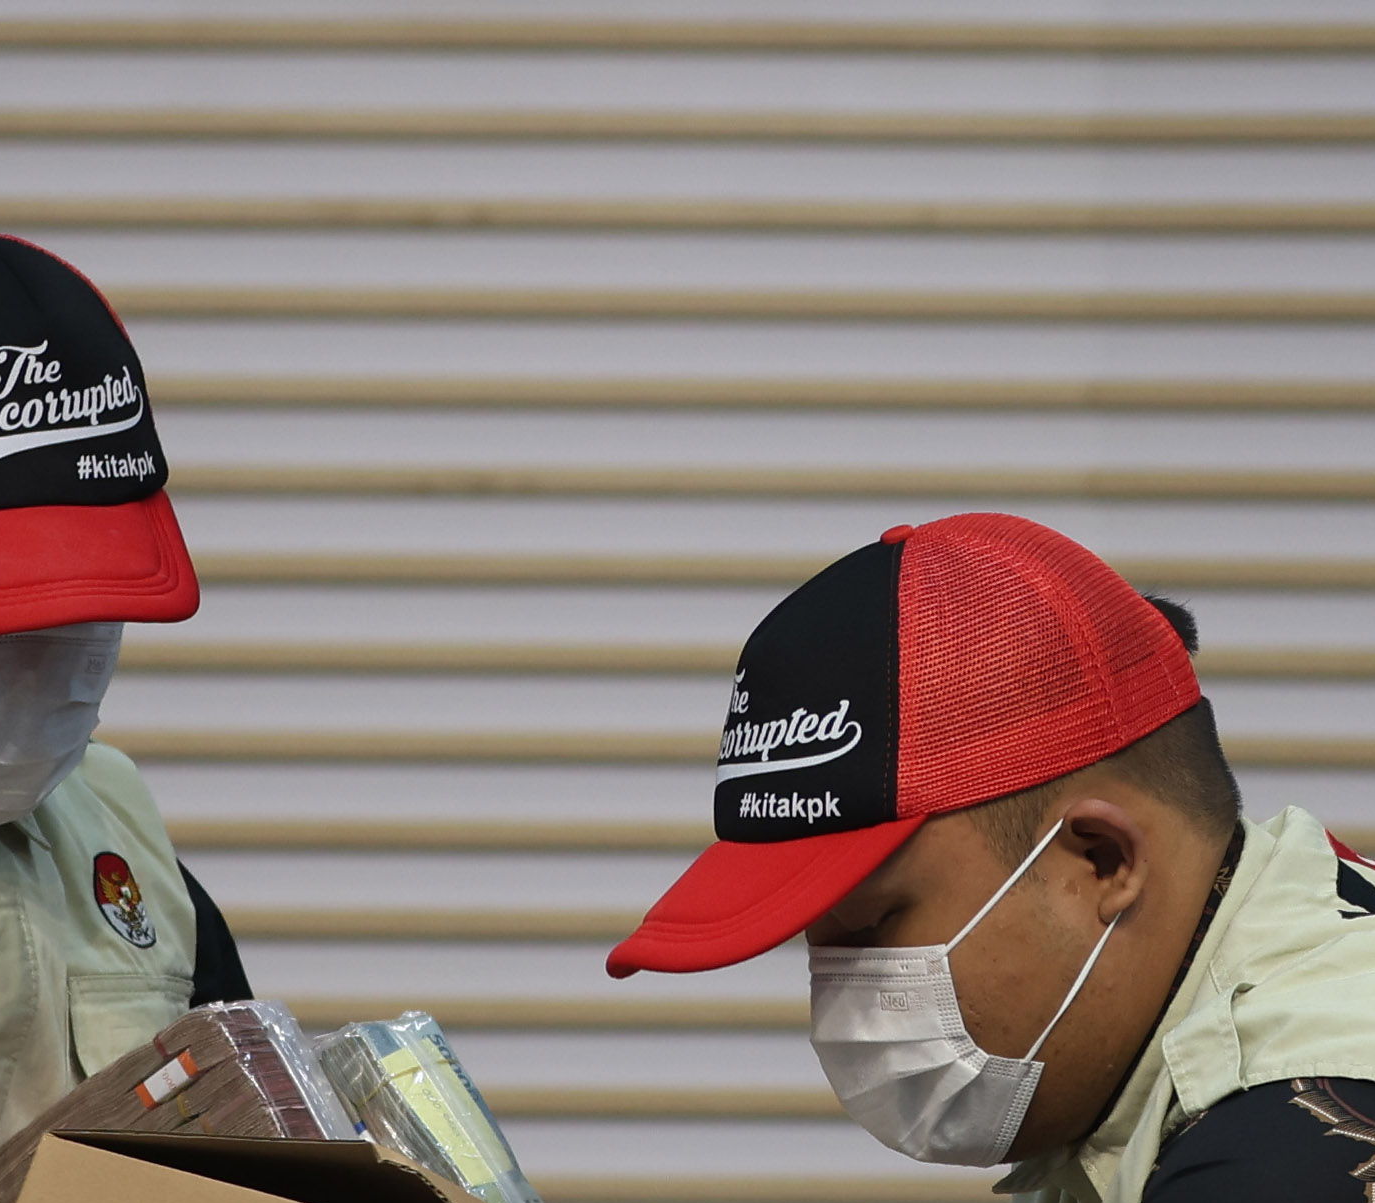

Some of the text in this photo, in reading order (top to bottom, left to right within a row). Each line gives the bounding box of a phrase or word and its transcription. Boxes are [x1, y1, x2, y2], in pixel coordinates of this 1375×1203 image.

[76, 451, 156, 482] #kitakpk
[730, 668, 749, 714] he
[720, 699, 848, 762] corrupted
[739, 791, 842, 824] #kitakpk
[126, 927, 154, 941] KPK
